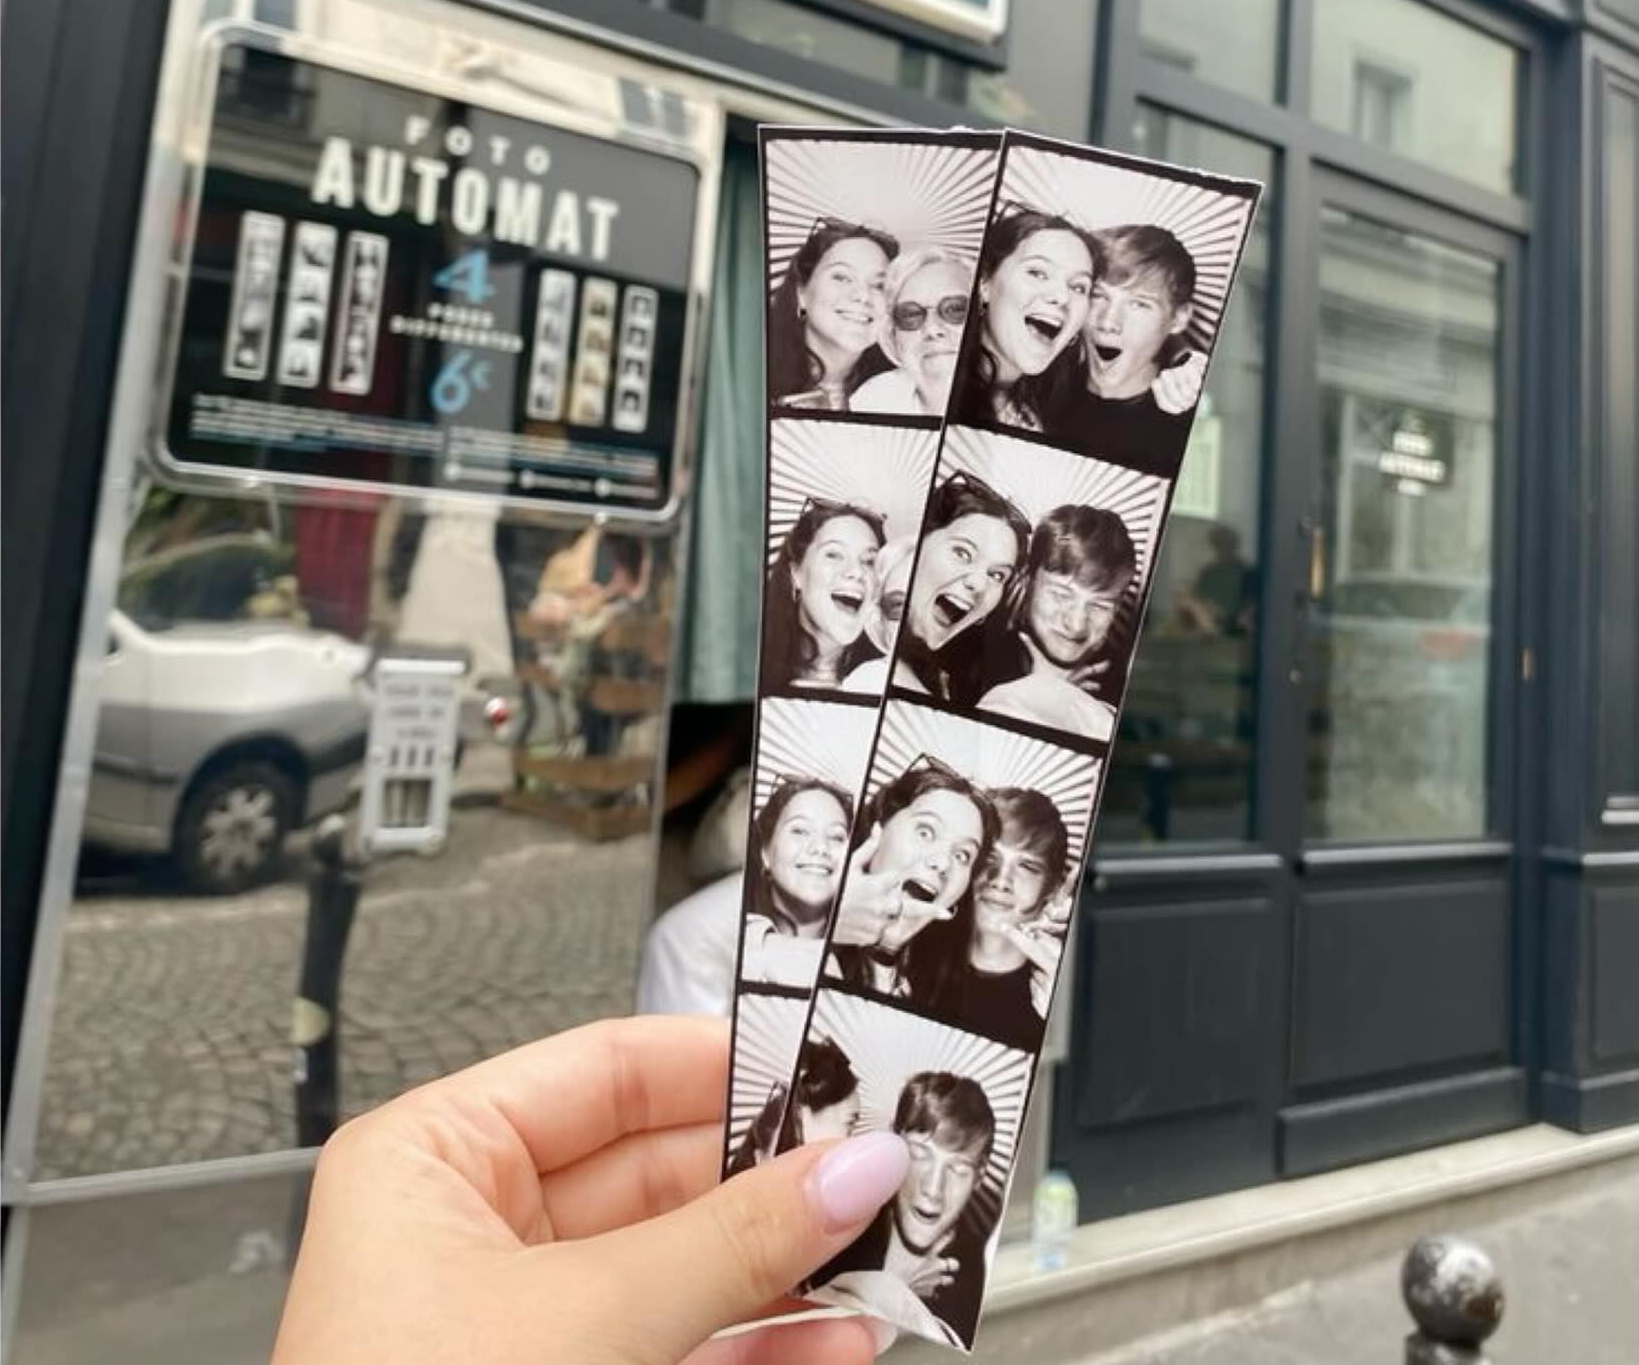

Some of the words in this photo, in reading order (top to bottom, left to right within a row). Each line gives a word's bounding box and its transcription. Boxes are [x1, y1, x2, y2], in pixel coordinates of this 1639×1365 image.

[404, 115, 551, 176] FOTO
[311, 136, 619, 261] AUTOMAT
[432, 247, 497, 305] 4
